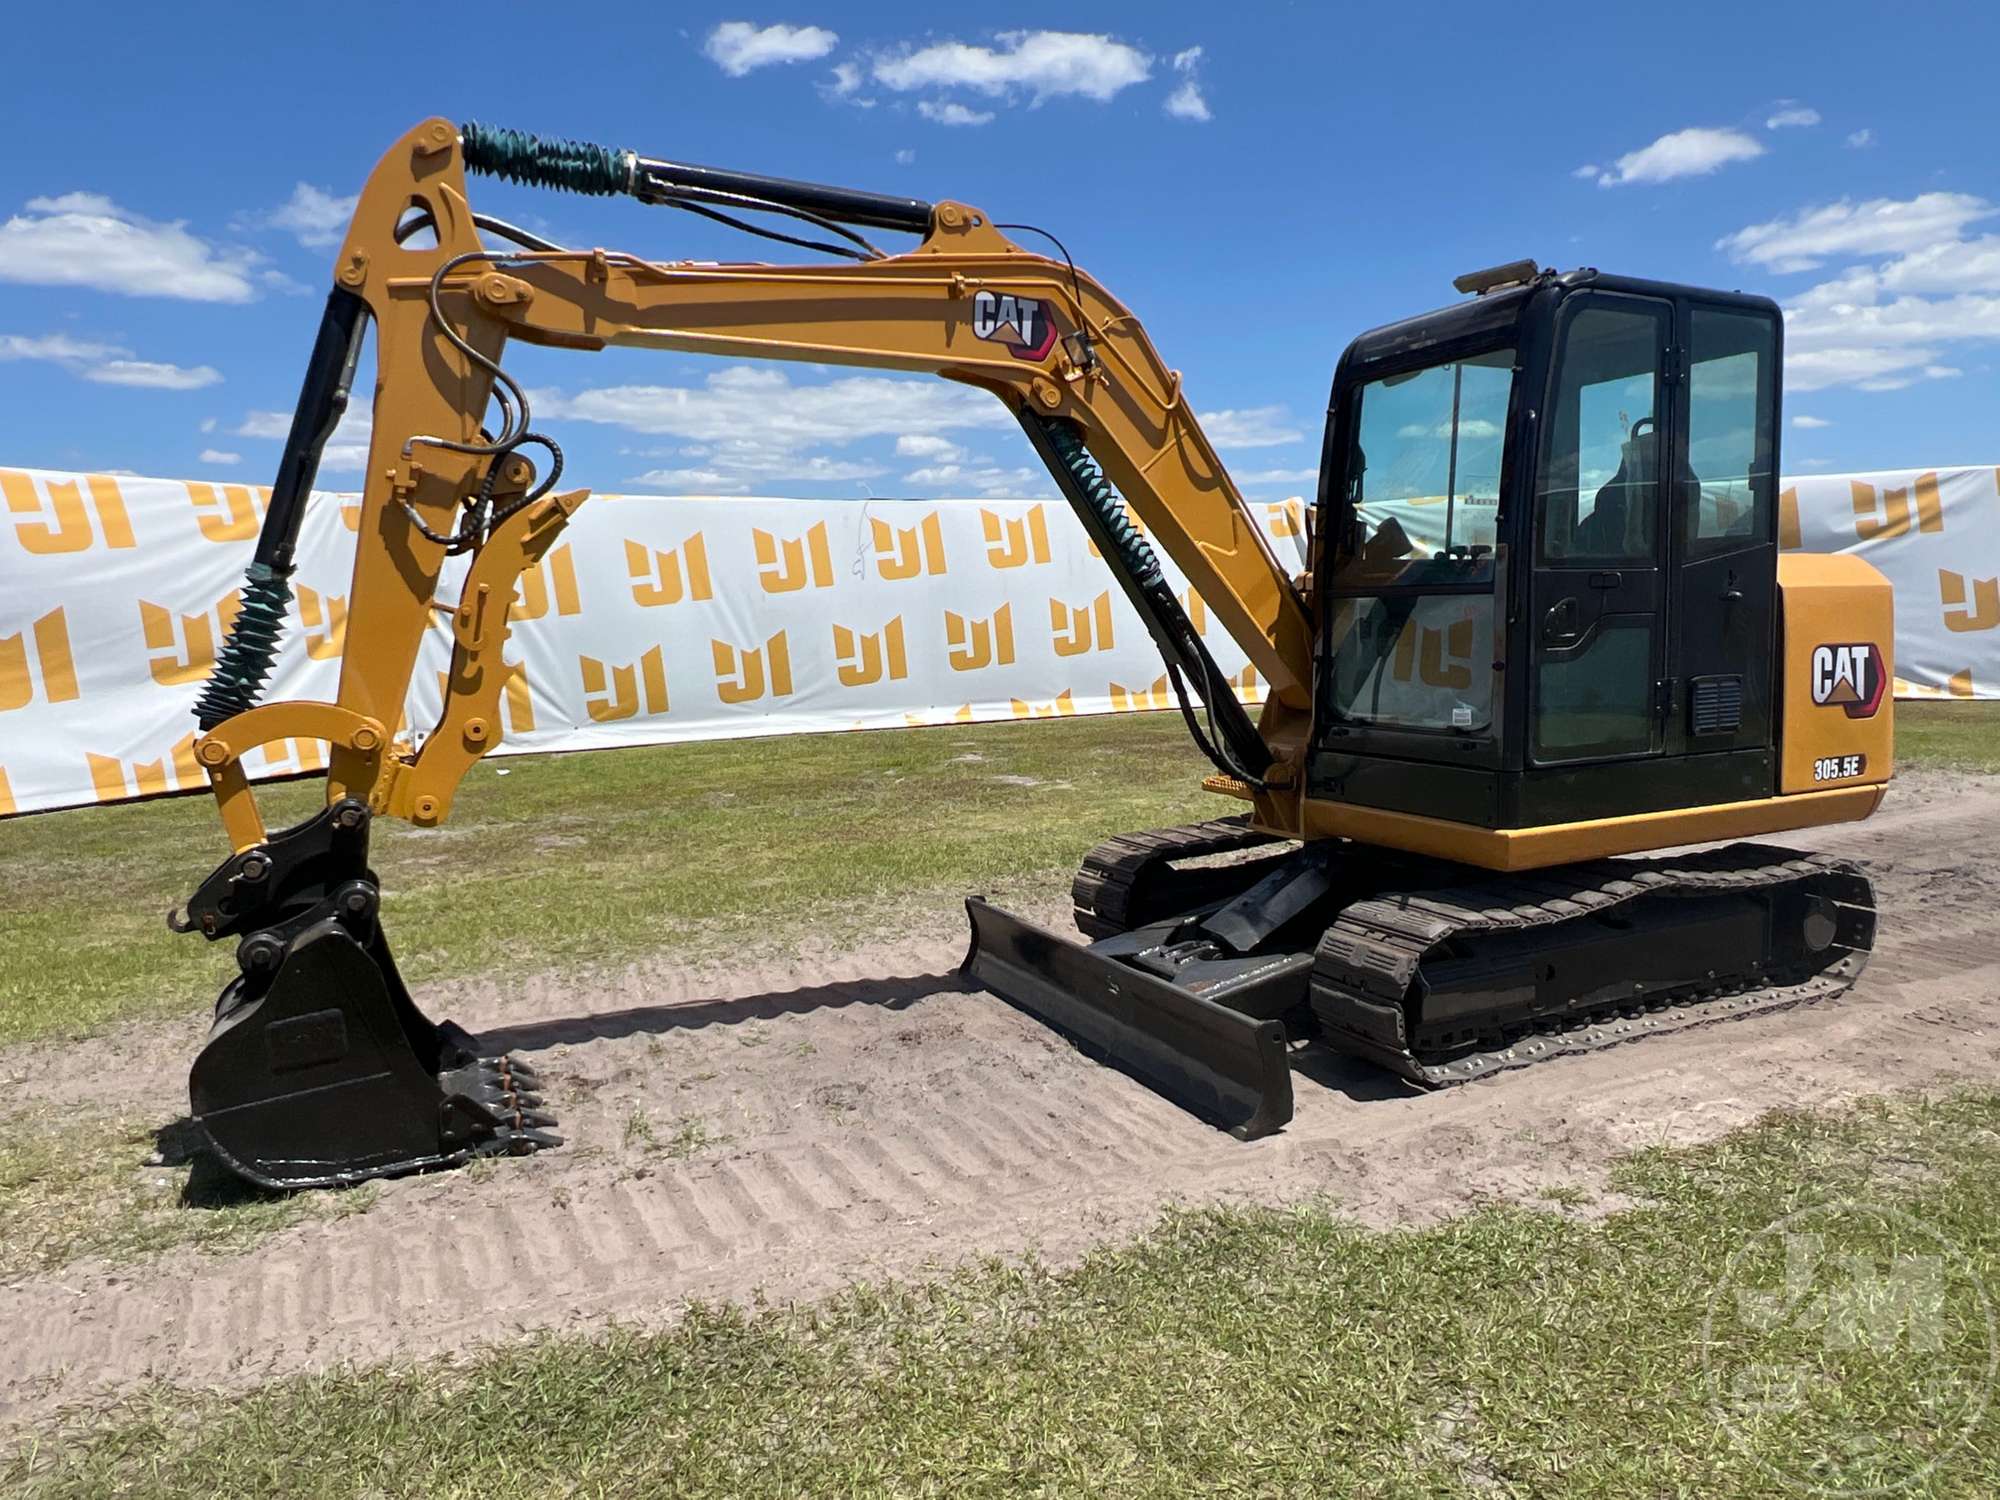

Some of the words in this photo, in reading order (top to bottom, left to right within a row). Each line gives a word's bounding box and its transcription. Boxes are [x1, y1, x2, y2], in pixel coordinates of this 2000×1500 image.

[974, 291, 1038, 346] CAT
[1813, 646, 1869, 704] CAT
[1814, 756, 1859, 780] 305.5E
